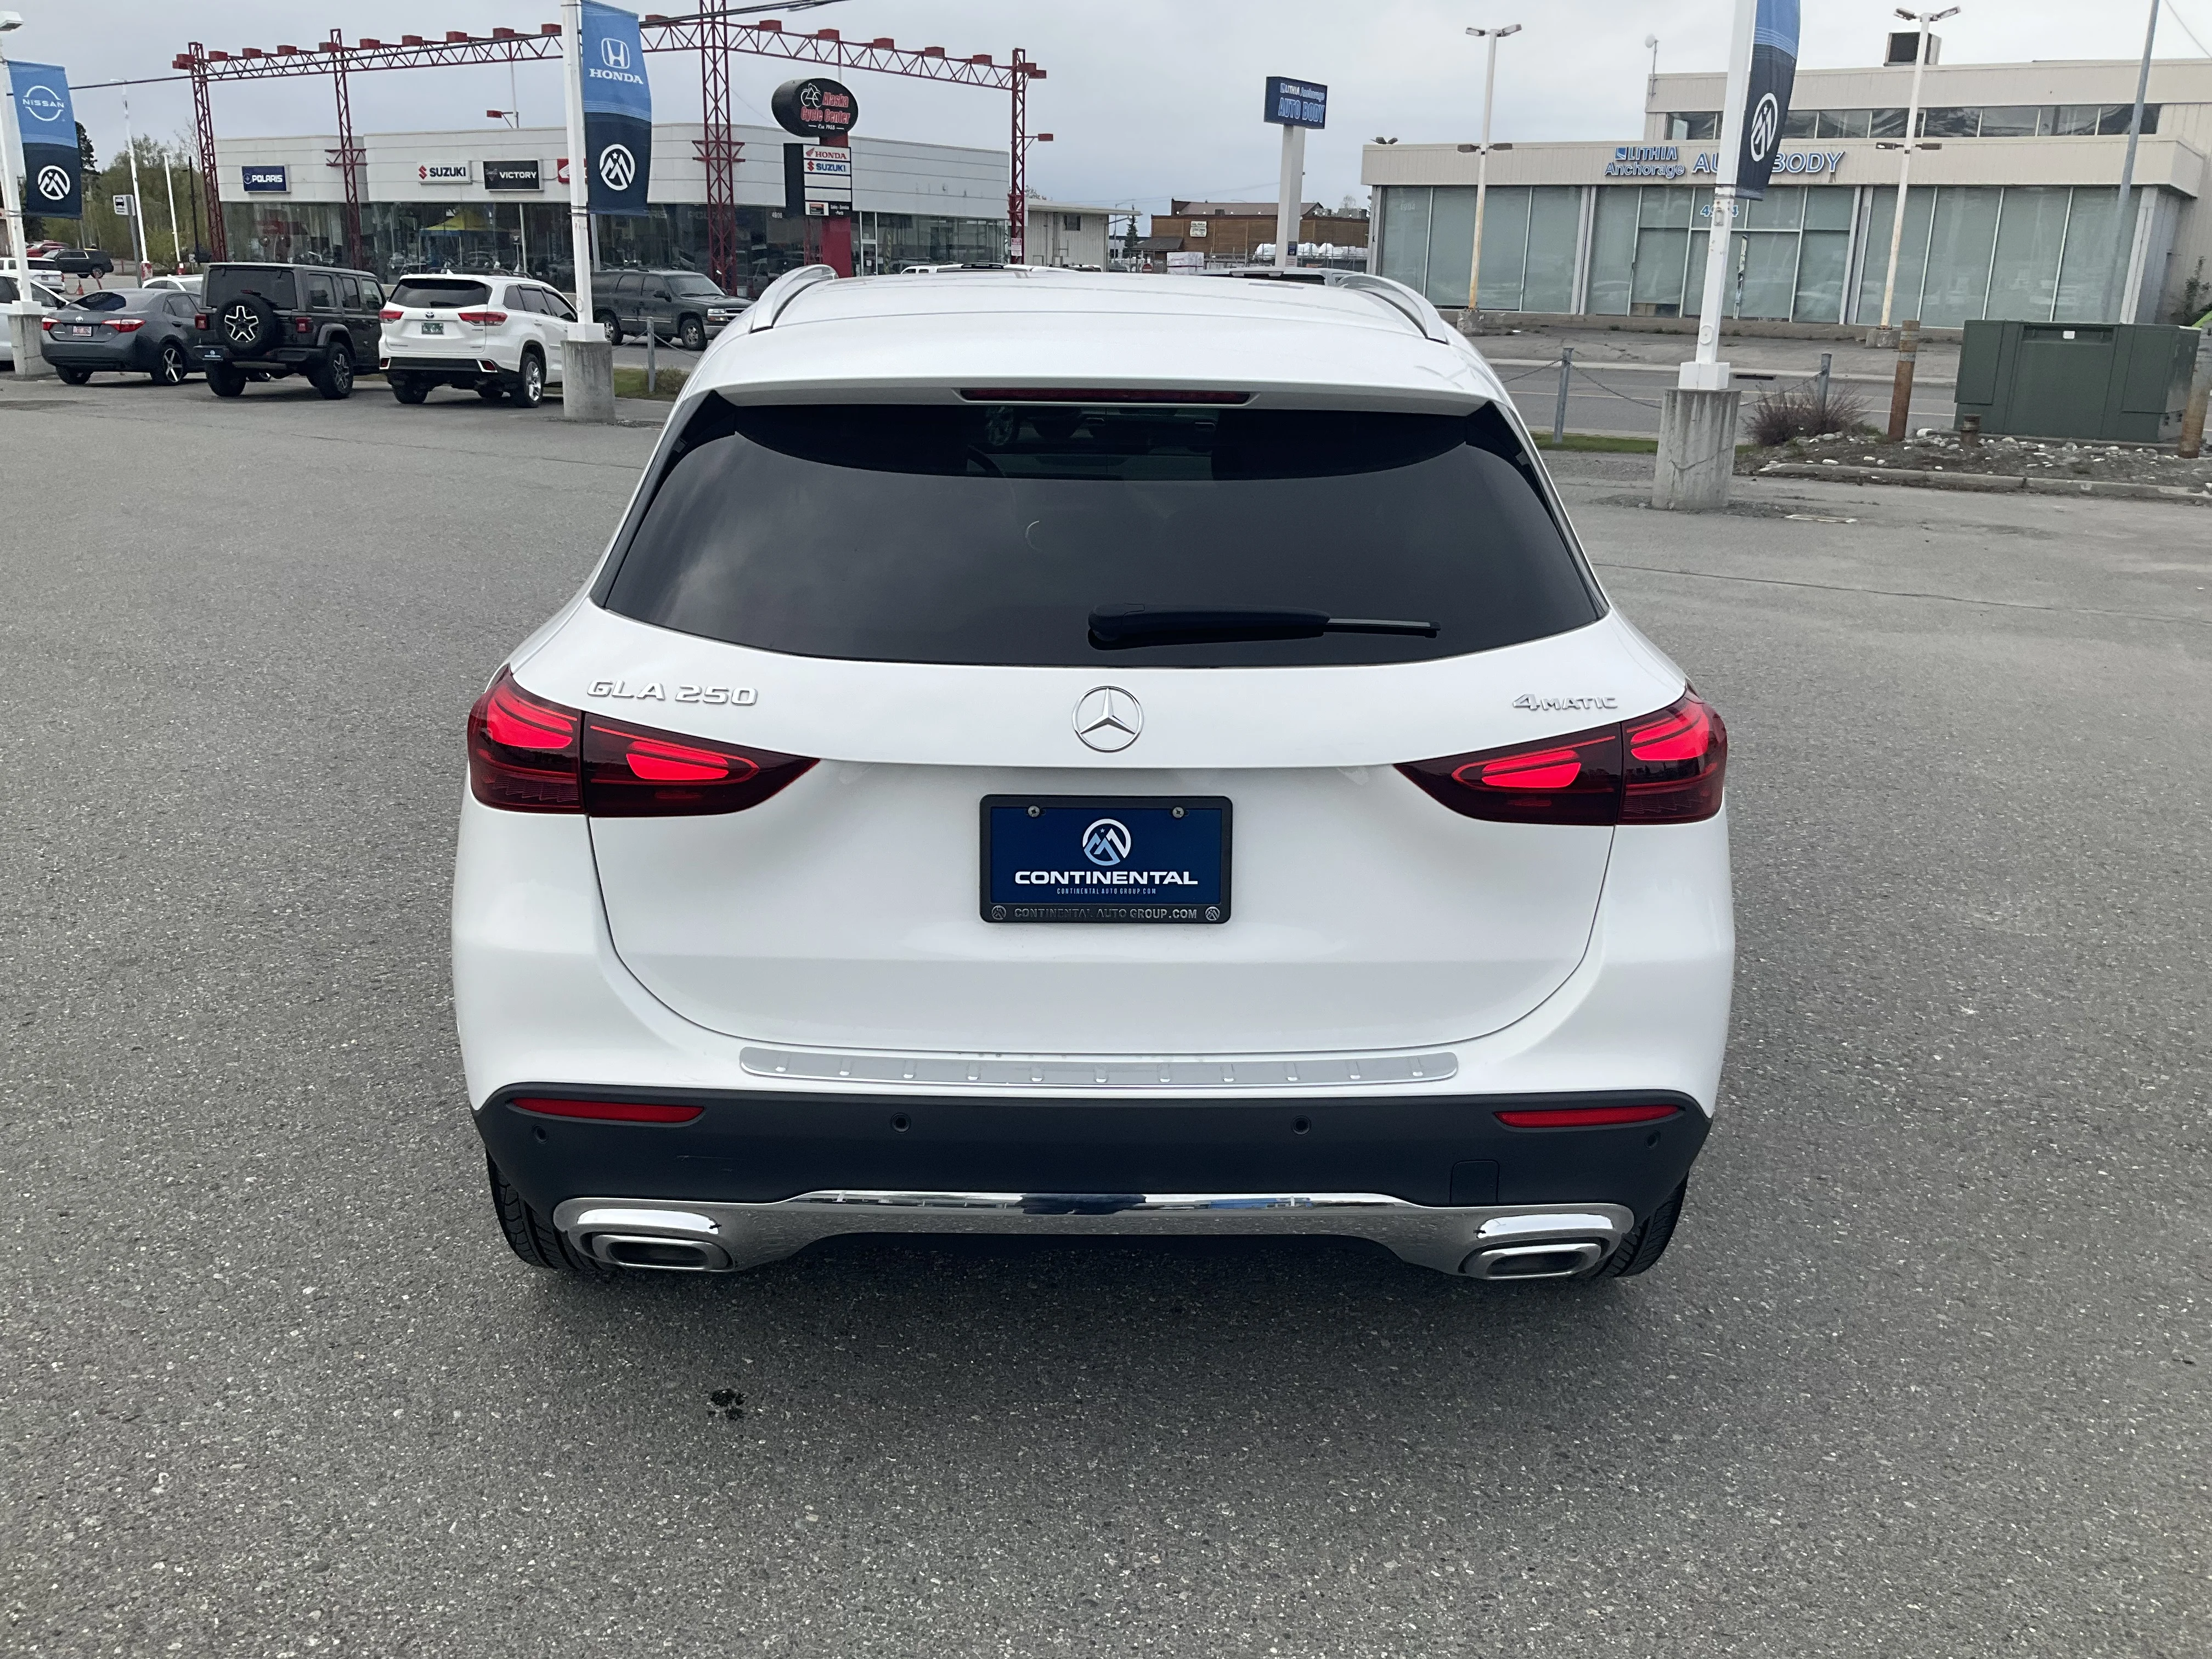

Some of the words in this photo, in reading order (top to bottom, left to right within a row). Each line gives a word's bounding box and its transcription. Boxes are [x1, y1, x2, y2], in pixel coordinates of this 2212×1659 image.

[589, 67, 644, 84] HONDA
[1285, 84, 1300, 96] LITHIA
[22, 98, 65, 108] NISSAN
[822, 92, 849, 108] Alaska
[800, 106, 823, 122] Cycle
[824, 109, 851, 124] Center
[1278, 97, 1301, 120] AUTO
[1302, 101, 1325, 123] BODY
[815, 151, 848, 160] HONDA
[1627, 146, 1678, 161] LITHIA
[429, 167, 466, 177] SUZUKI
[816, 163, 846, 172] SUZUKI
[1604, 162, 1685, 179] Anchorage
[252, 174, 283, 183] POLARIS
[499, 171, 537, 179] VICTORY
[587, 680, 665, 701] GLA
[675, 684, 758, 706] 250
[1513, 693, 1618, 711] 4MATIC
[1015, 871, 1198, 885] CONTINENTAL
[1014, 908, 1093, 919] CONTINENTAL
[1097, 909, 1127, 919] AUTO
[1129, 909, 1197, 919] GROUP.COM
